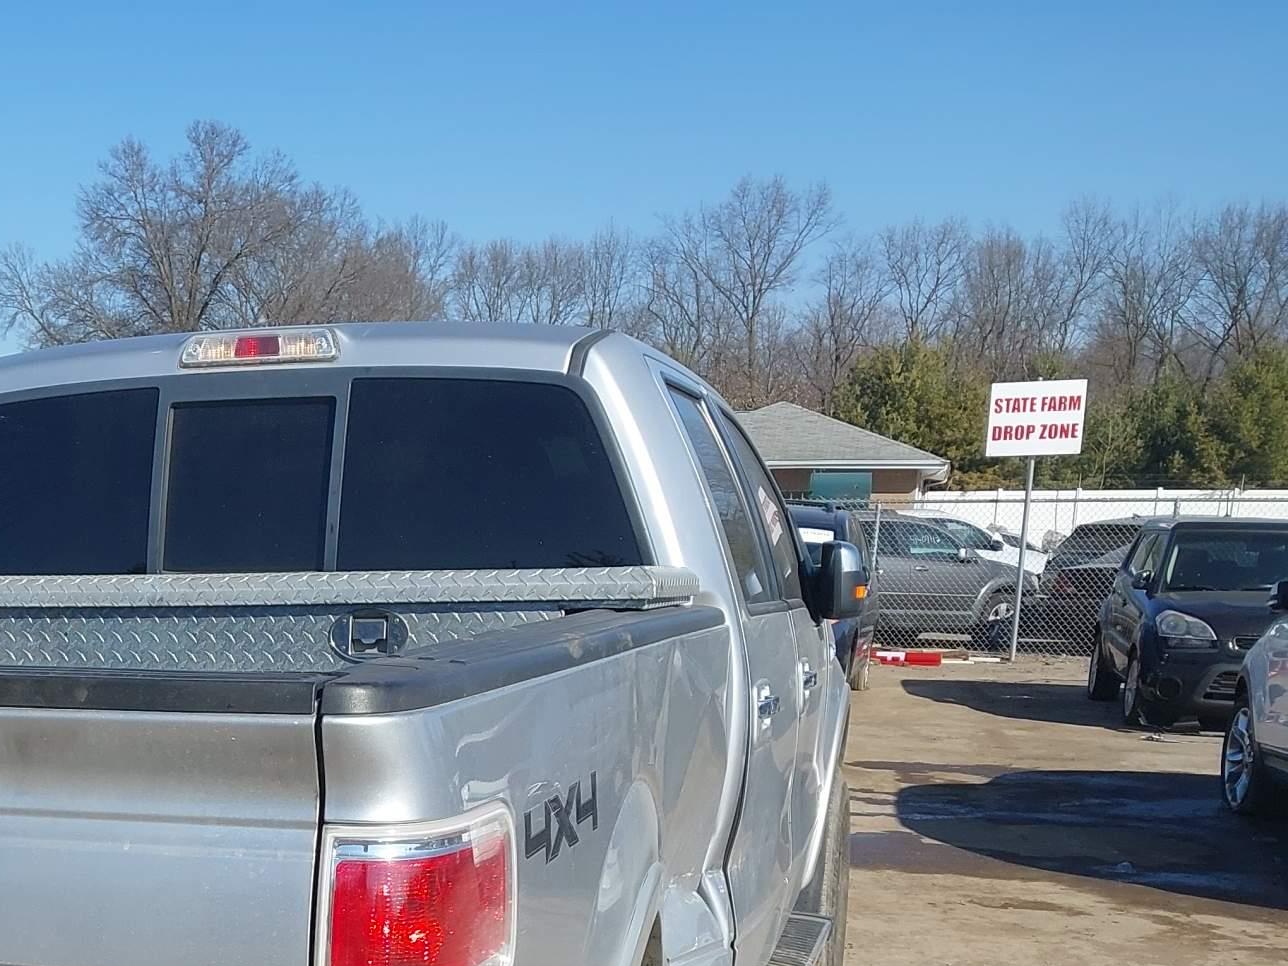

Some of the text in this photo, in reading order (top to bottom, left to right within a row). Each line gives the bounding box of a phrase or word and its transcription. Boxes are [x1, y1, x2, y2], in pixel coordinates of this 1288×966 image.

[994, 395, 1082, 414] STATE FARM
[992, 423, 1079, 441] DROP ZONE
